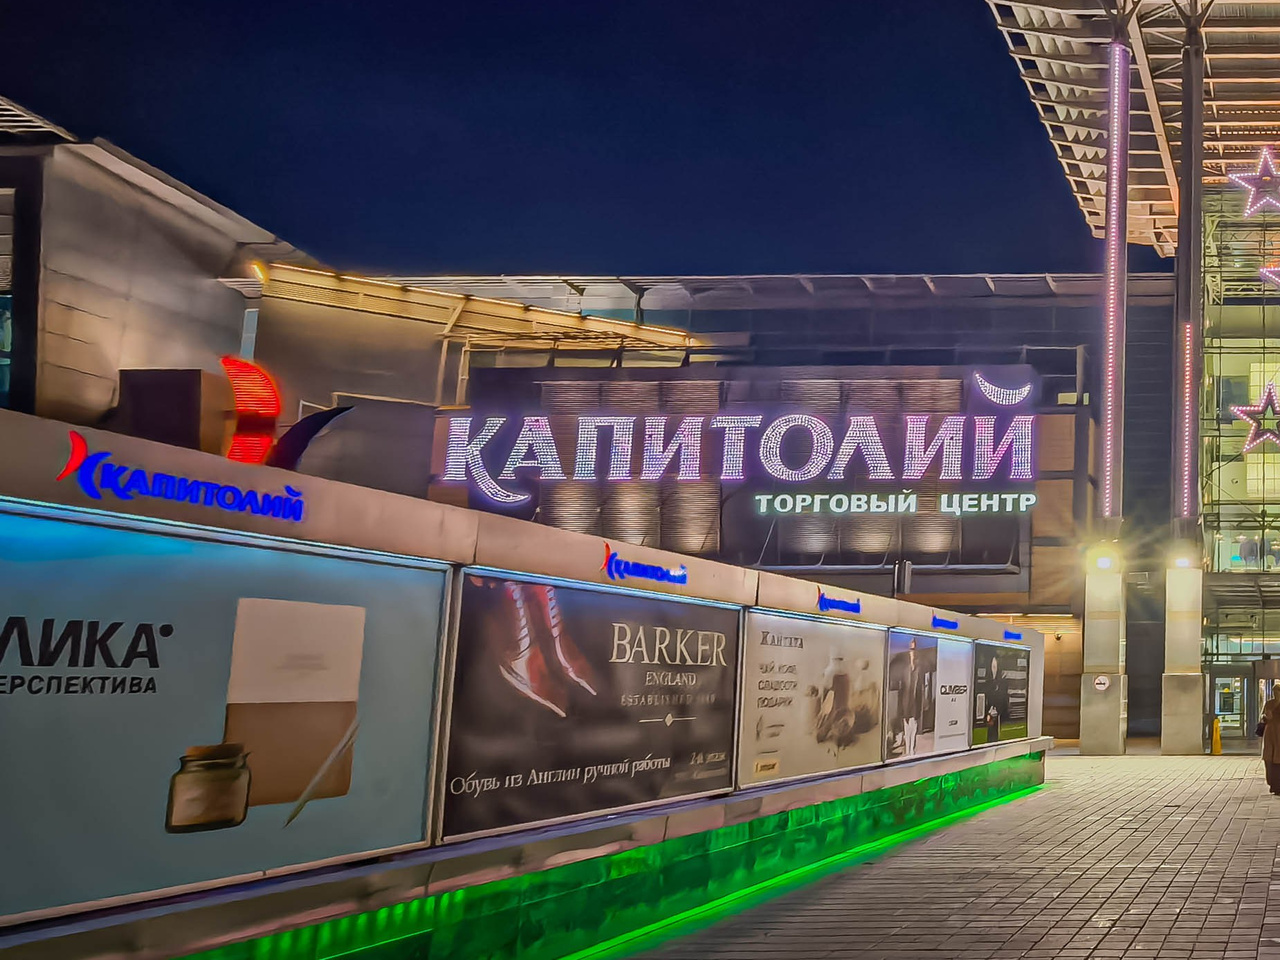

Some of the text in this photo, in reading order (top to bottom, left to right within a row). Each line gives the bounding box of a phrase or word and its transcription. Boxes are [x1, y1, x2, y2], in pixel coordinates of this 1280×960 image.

[441, 373, 1037, 504] КАПИТОЛИЙ
[99, 462, 304, 522] КАПИТОЛИЙ
[755, 489, 1037, 516] ТОРГОВЫЙ ЦЕНТР
[608, 623, 728, 667] BARKER
[645, 671, 697, 686] ENGLAND
[450, 770, 500, 798] Обувь
[504, 775, 523, 788] из
[527, 768, 581, 786] Англии
[583, 758, 629, 784] ручной
[631, 753, 671, 778] работы
